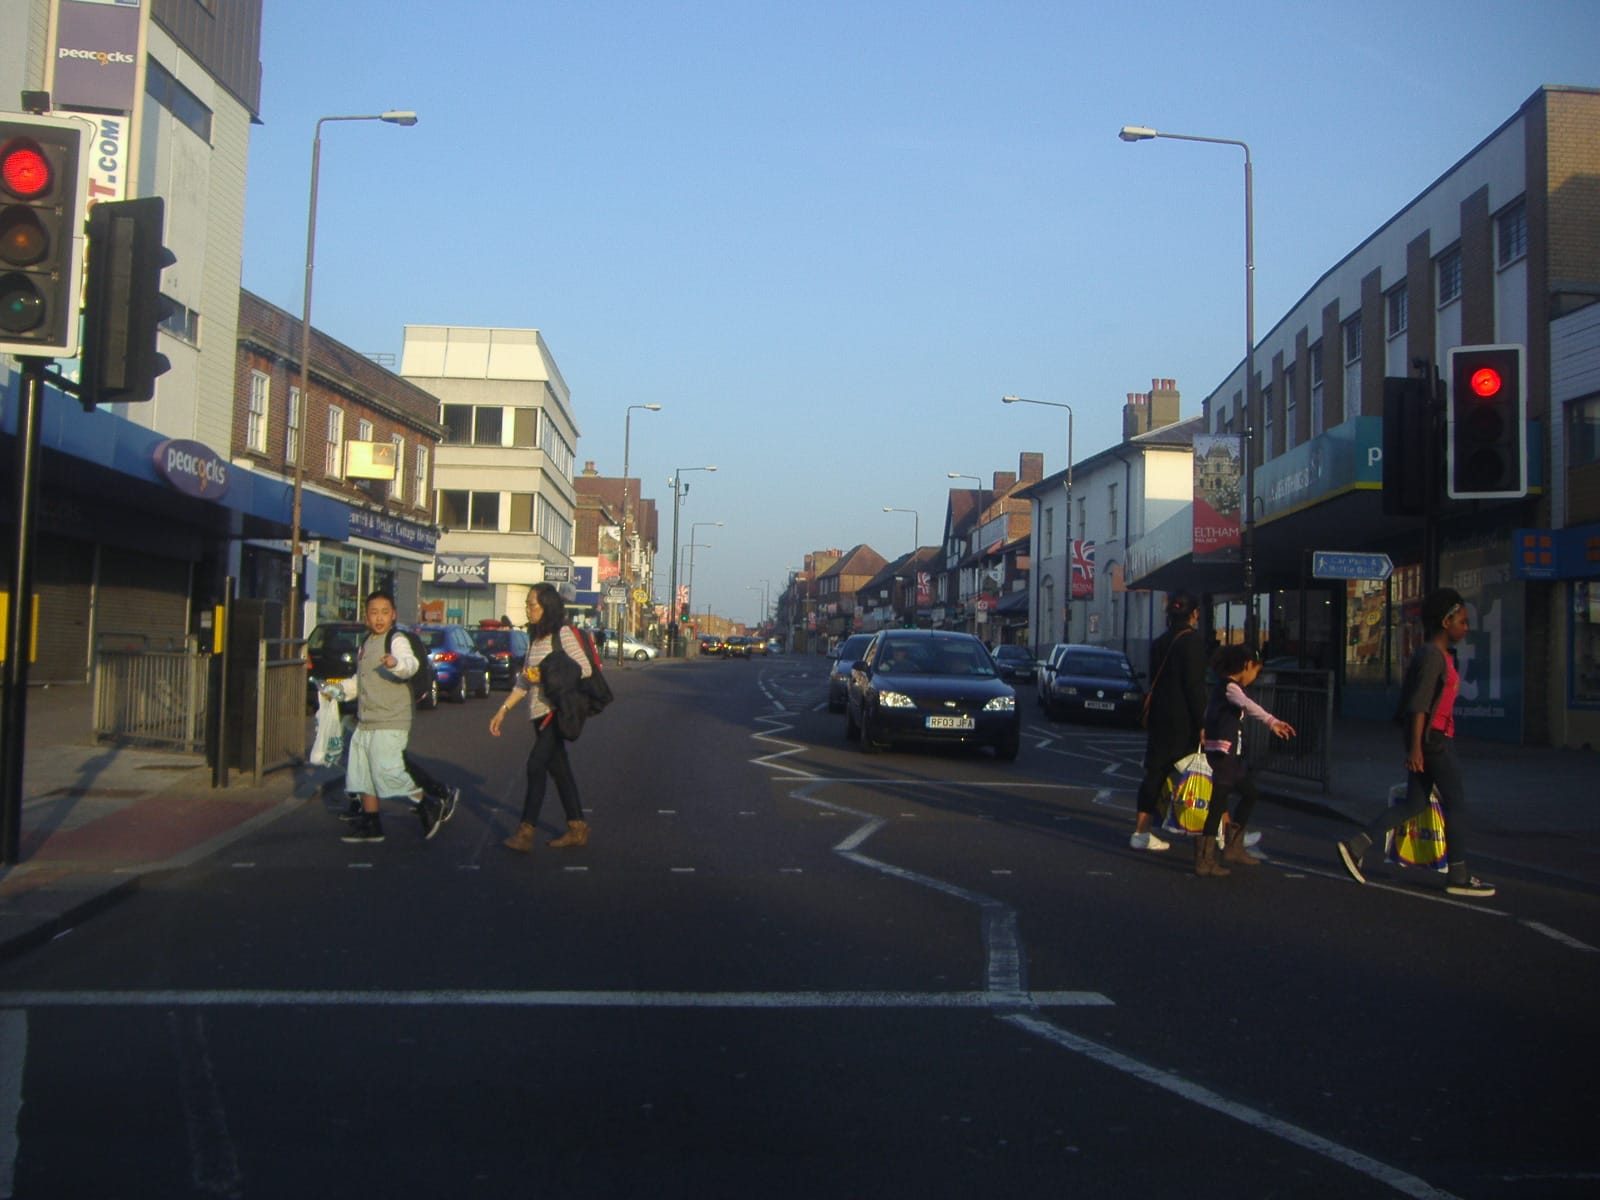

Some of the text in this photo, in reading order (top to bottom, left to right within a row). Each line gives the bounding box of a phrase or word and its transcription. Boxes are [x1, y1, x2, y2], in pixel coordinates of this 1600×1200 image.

[58, 47, 134, 65] peacocks
[167, 448, 226, 489] peacocks
[1194, 527, 1240, 538] ELTHAM
[437, 564, 486, 576] HALIFAX
[930, 718, 974, 729] RF03 JFA
